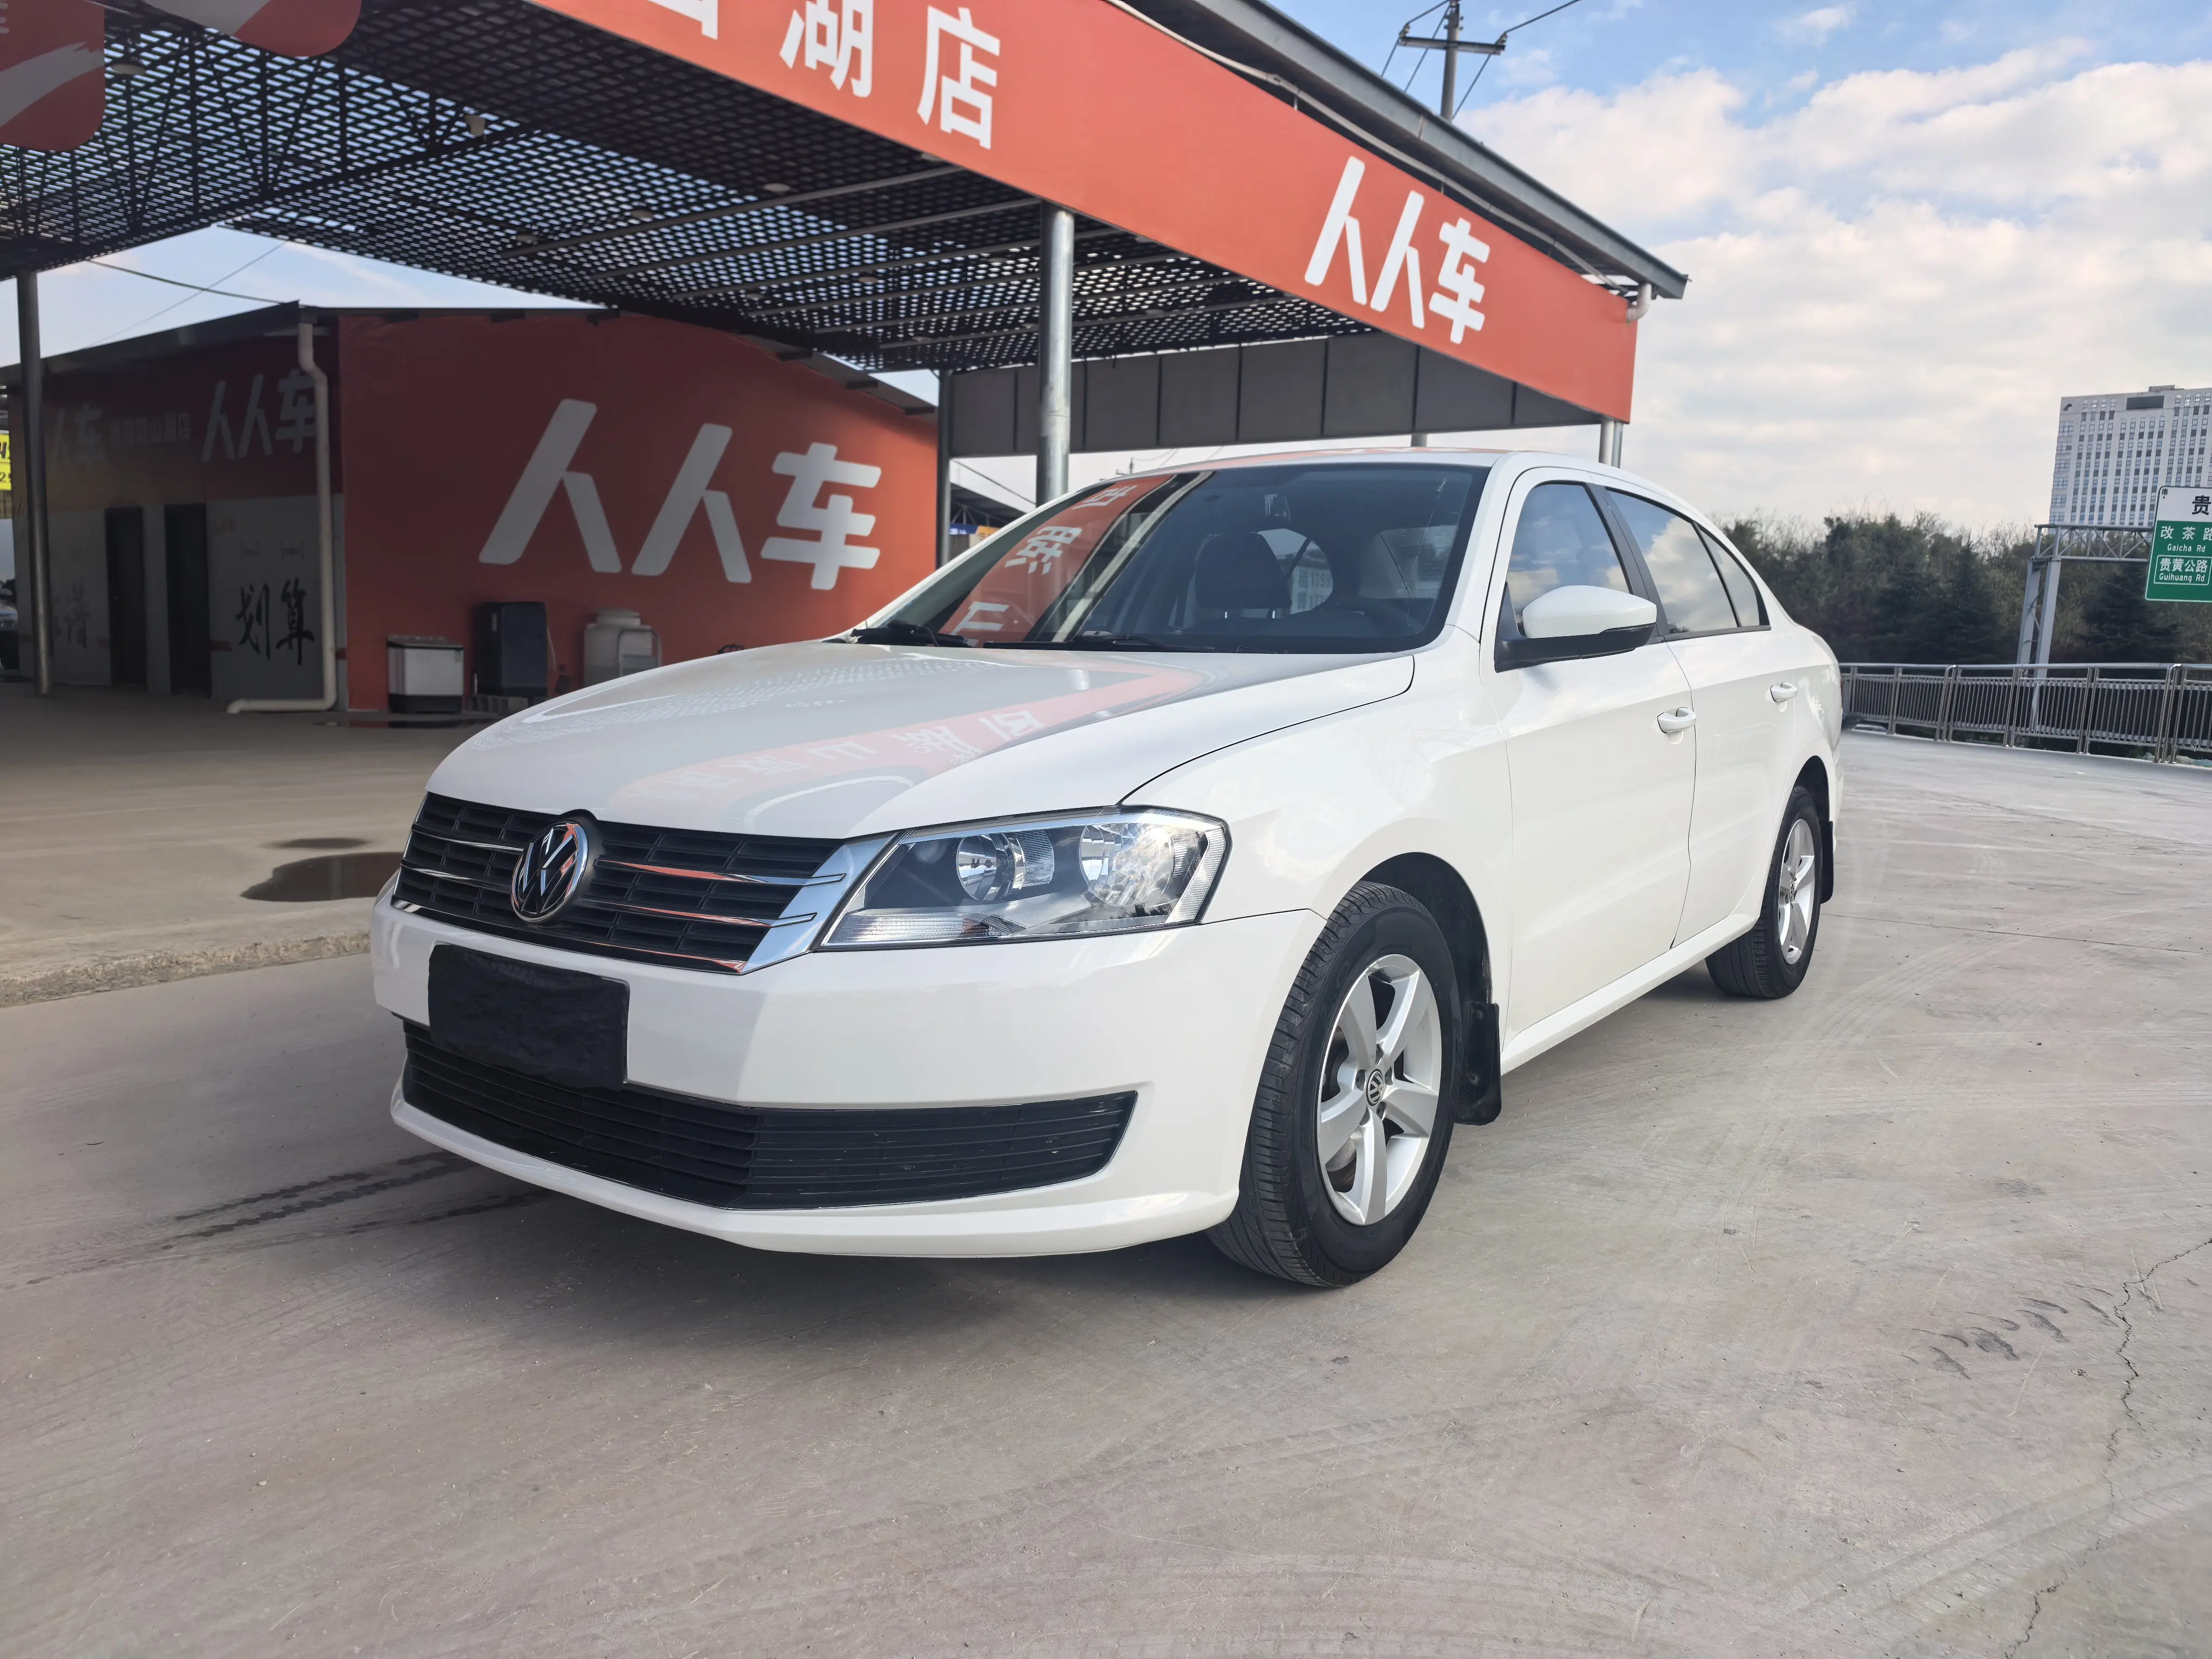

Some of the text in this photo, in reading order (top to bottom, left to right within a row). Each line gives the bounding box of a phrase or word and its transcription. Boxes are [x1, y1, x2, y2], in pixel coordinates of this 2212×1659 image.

[1304, 156, 1490, 344] 人人车
[51, 404, 106, 475] 人车
[201, 369, 316, 462] 人人车
[478, 399, 881, 590] 人人车
[2160, 525, 2212, 541] 改茶路
[2160, 557, 2208, 573] 贵黄公路
[2167, 543, 2192, 551] Gaicha
[2195, 574, 2206, 582] Rd
[235, 577, 315, 666] 划算
